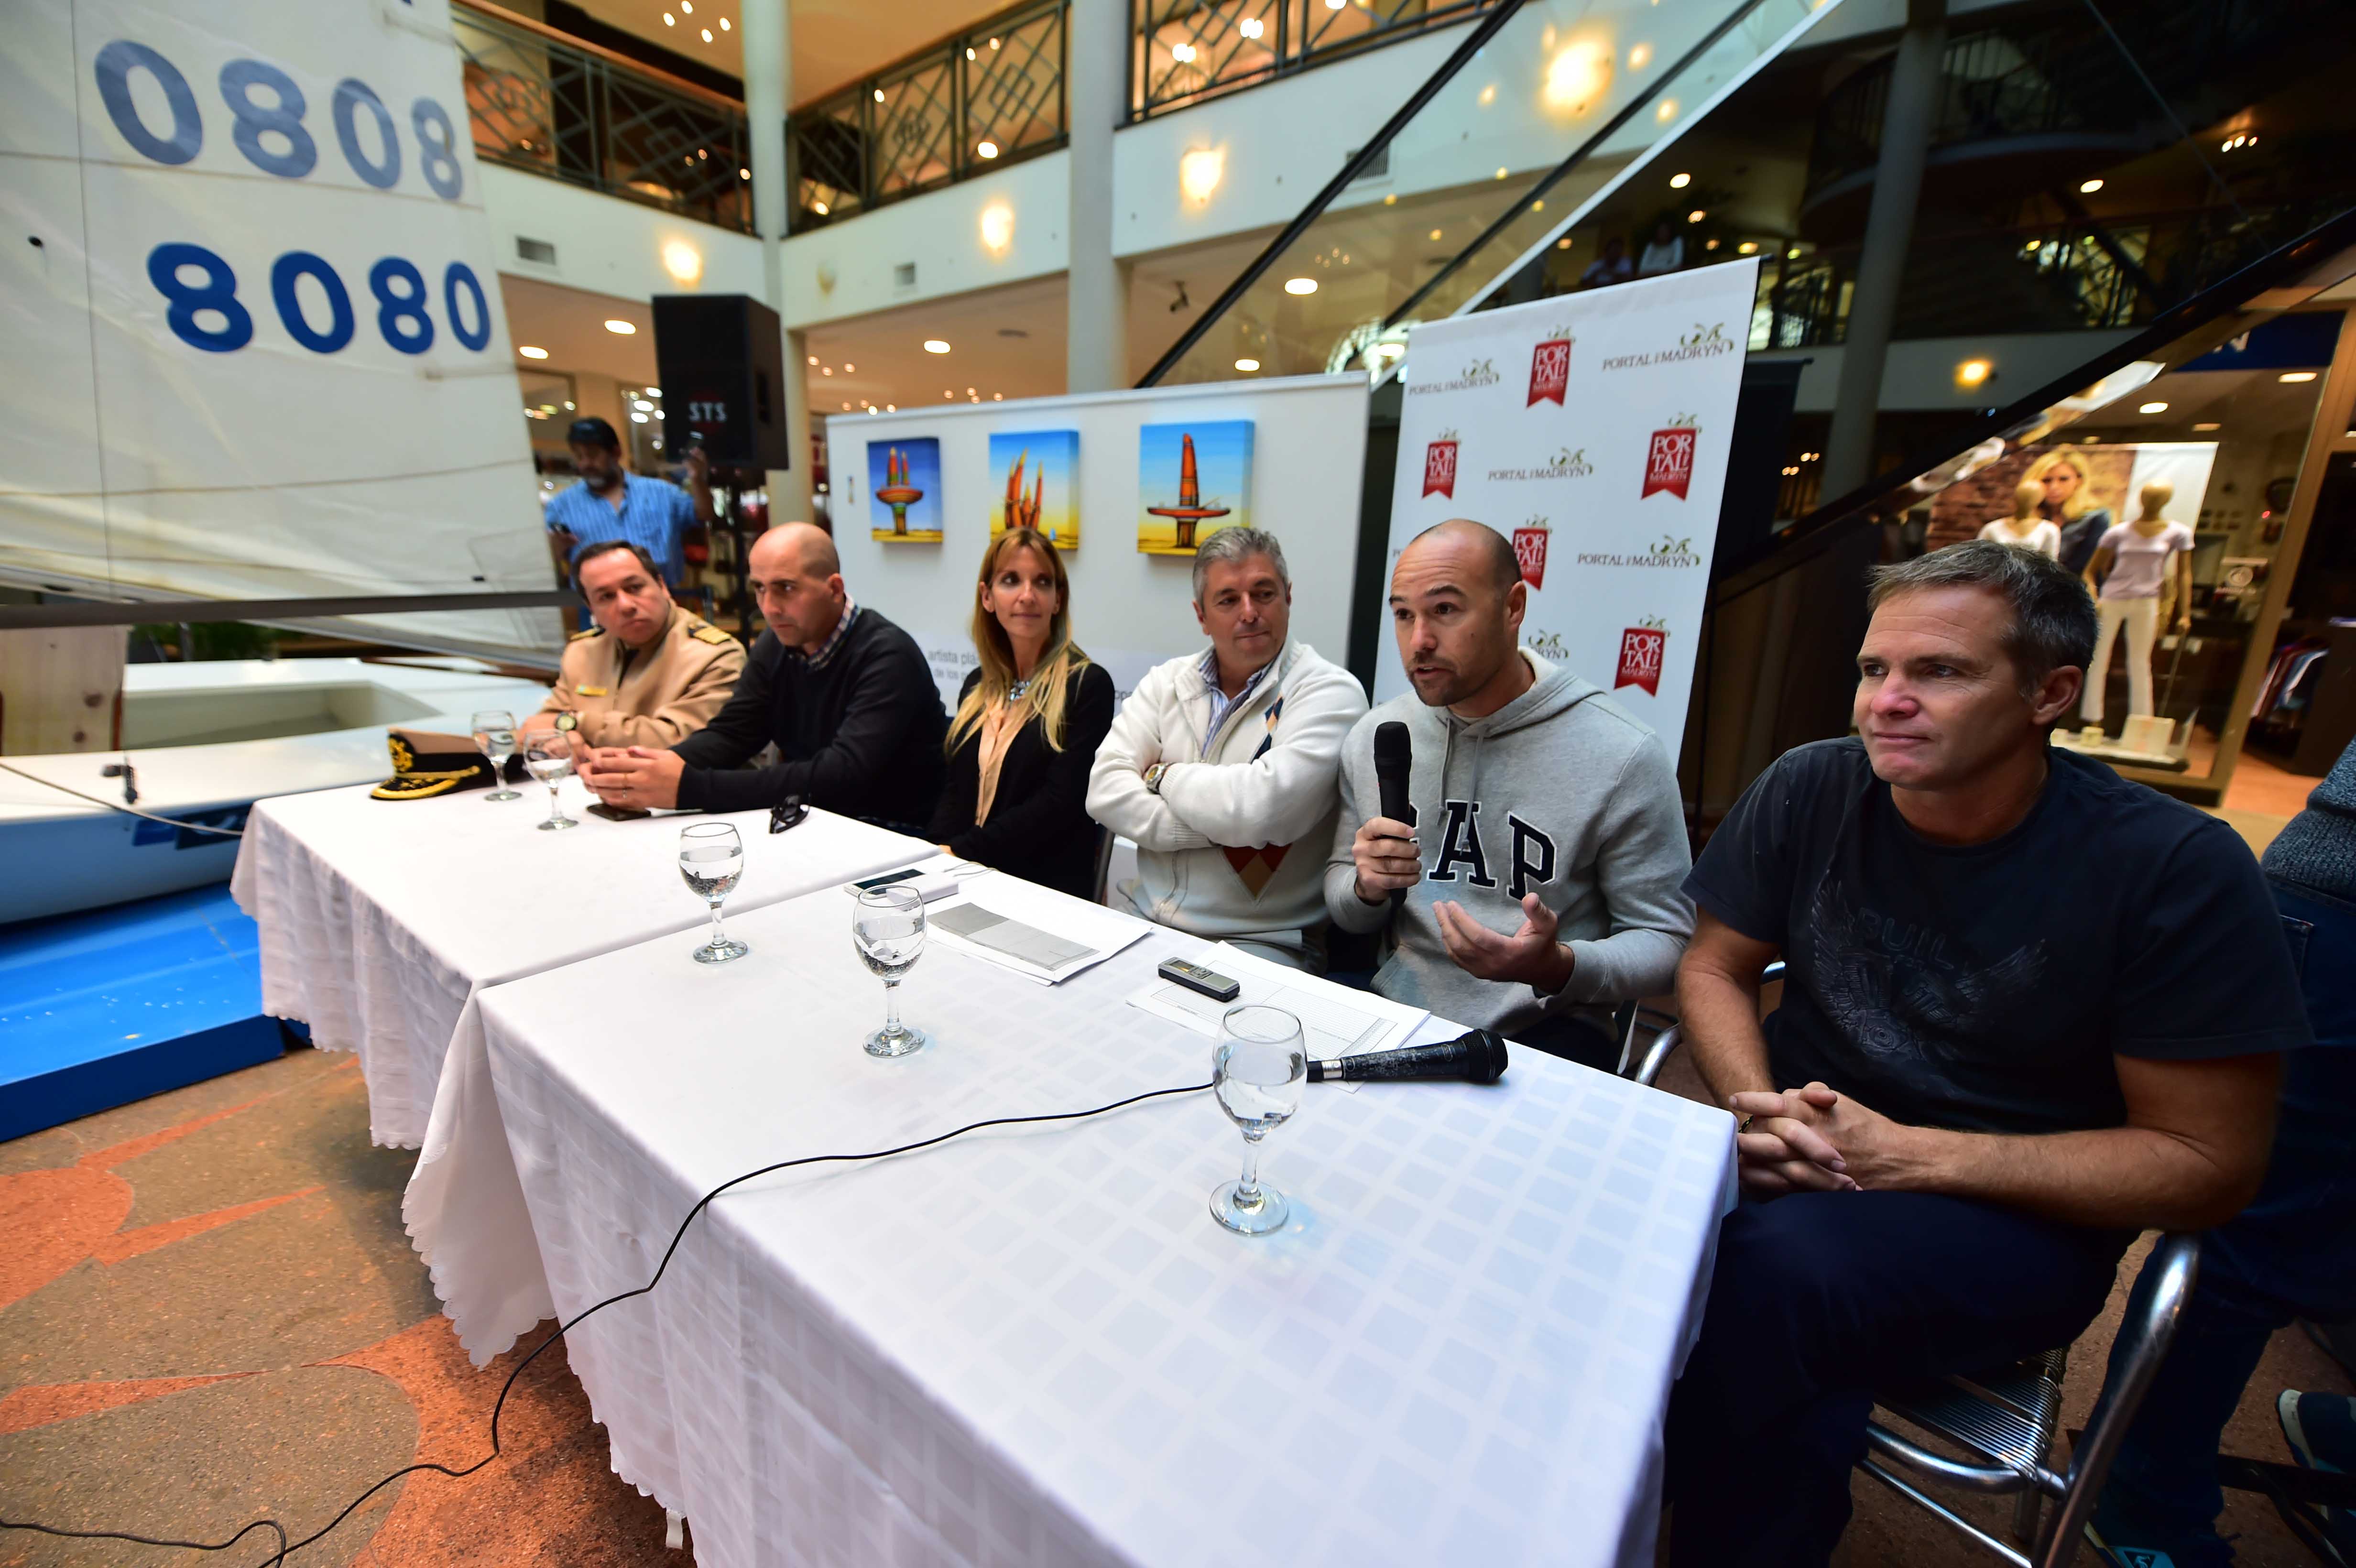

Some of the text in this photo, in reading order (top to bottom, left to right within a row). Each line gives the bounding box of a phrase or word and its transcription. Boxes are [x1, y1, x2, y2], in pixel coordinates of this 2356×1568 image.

[146, 241, 491, 355] 8080
[1535, 345, 1568, 368] POR
[1602, 353, 1652, 372] PORTAL
[1659, 341, 1724, 364] MADRYN
[689, 402, 727, 422] STS
[1653, 434, 1692, 457] POR
[1488, 469, 1527, 481] PORTAL
[1534, 466, 1585, 479] MADRYN
[1515, 533, 1545, 551] POR
[1578, 553, 1624, 566] PORTAL
[1632, 553, 1691, 568] MADRYN
[1625, 633, 1661, 653] POR
[928, 650, 958, 663] artista
[1409, 799, 1557, 902] AP
